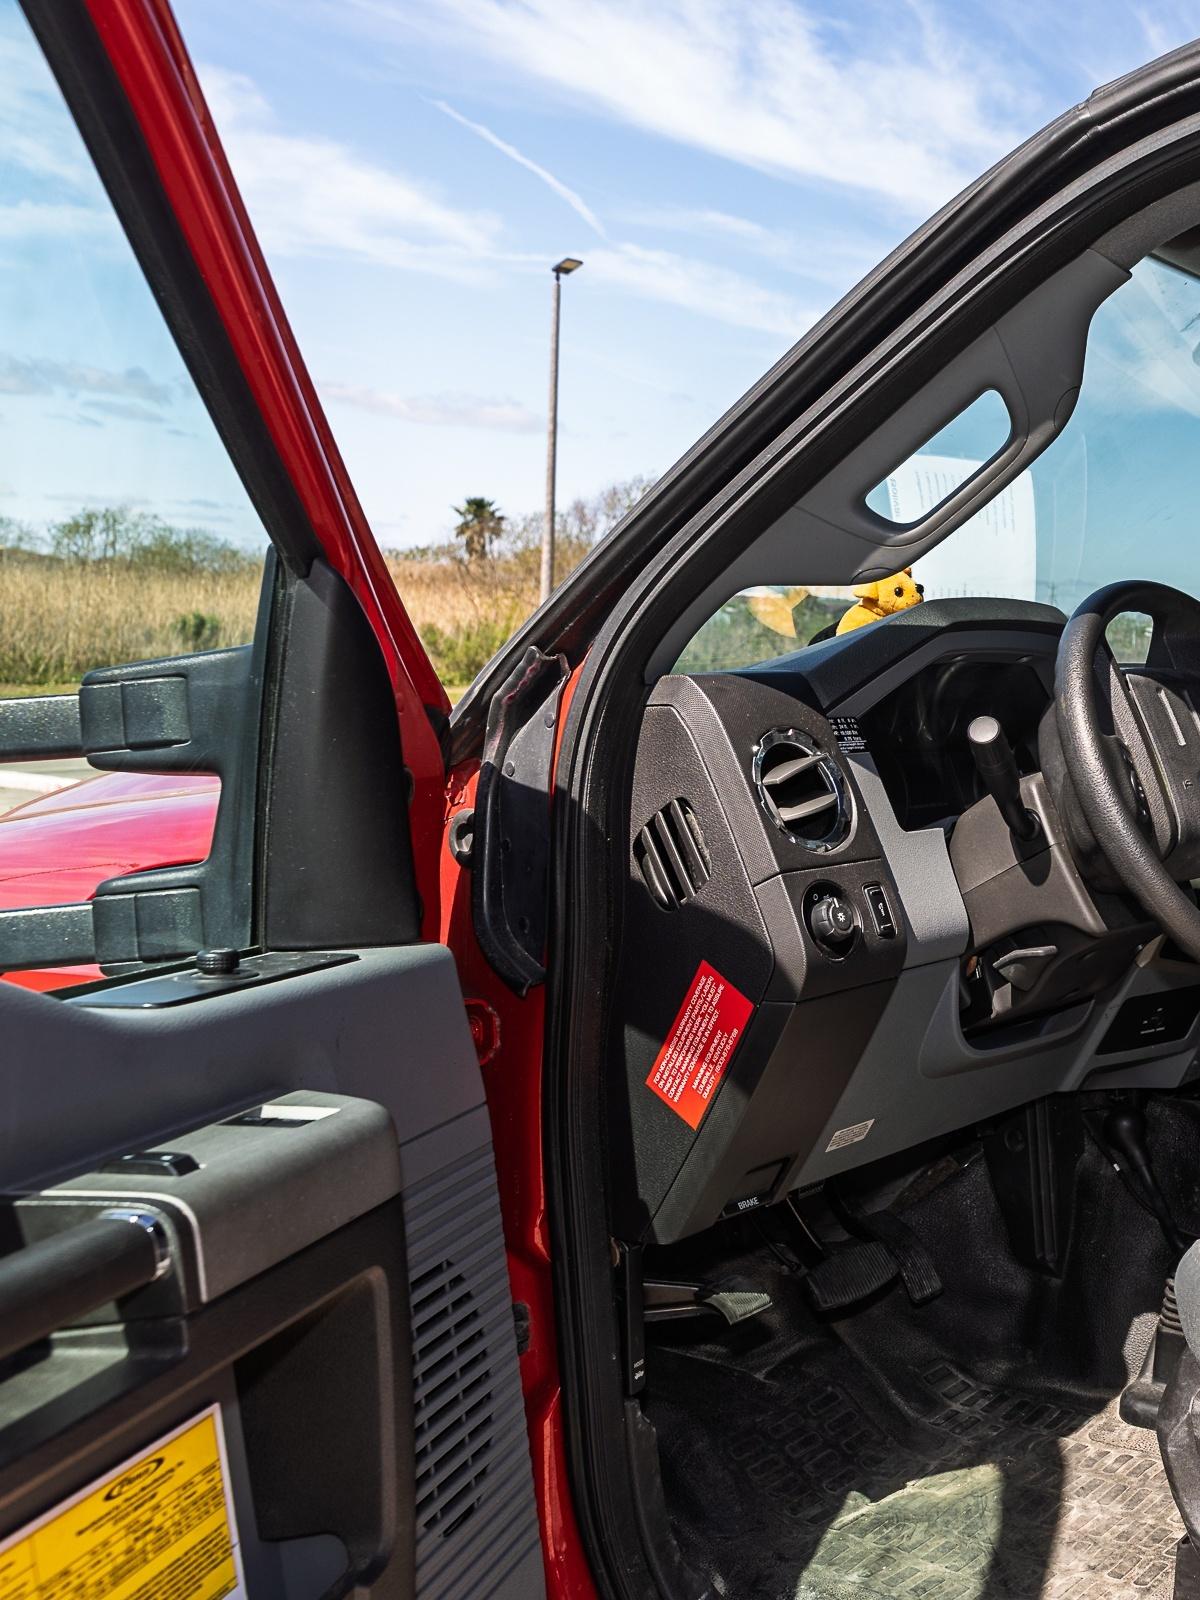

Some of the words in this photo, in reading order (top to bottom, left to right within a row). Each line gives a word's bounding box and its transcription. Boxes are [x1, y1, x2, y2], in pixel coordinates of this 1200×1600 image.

[675, 1003, 693, 1037] WARRANTY
[690, 975, 706, 1005] COVERAGE
[662, 1049, 678, 1080] INSTALLED
[675, 1017, 694, 1051] EQUIPMENT
[663, 1074, 674, 1094] PRIOR
[674, 1032, 694, 1069] PERFORMING
[668, 1072, 682, 1098] CONTACT
[680, 1045, 695, 1073] MANNING
[692, 1014, 710, 1047] EQUIPMENT
[711, 983, 724, 1006] ASSURE
[691, 1061, 707, 1090] MANNING
[704, 1029, 722, 1063] EQUIPMENT
[712, 1032, 728, 1063] KENTUCKY
[673, 1070, 690, 1103] WARRANTY
[687, 1042, 704, 1072] COVERAGE
[702, 1074, 716, 1099] QUALITY
[738, 1197, 759, 1210] BRAKE
